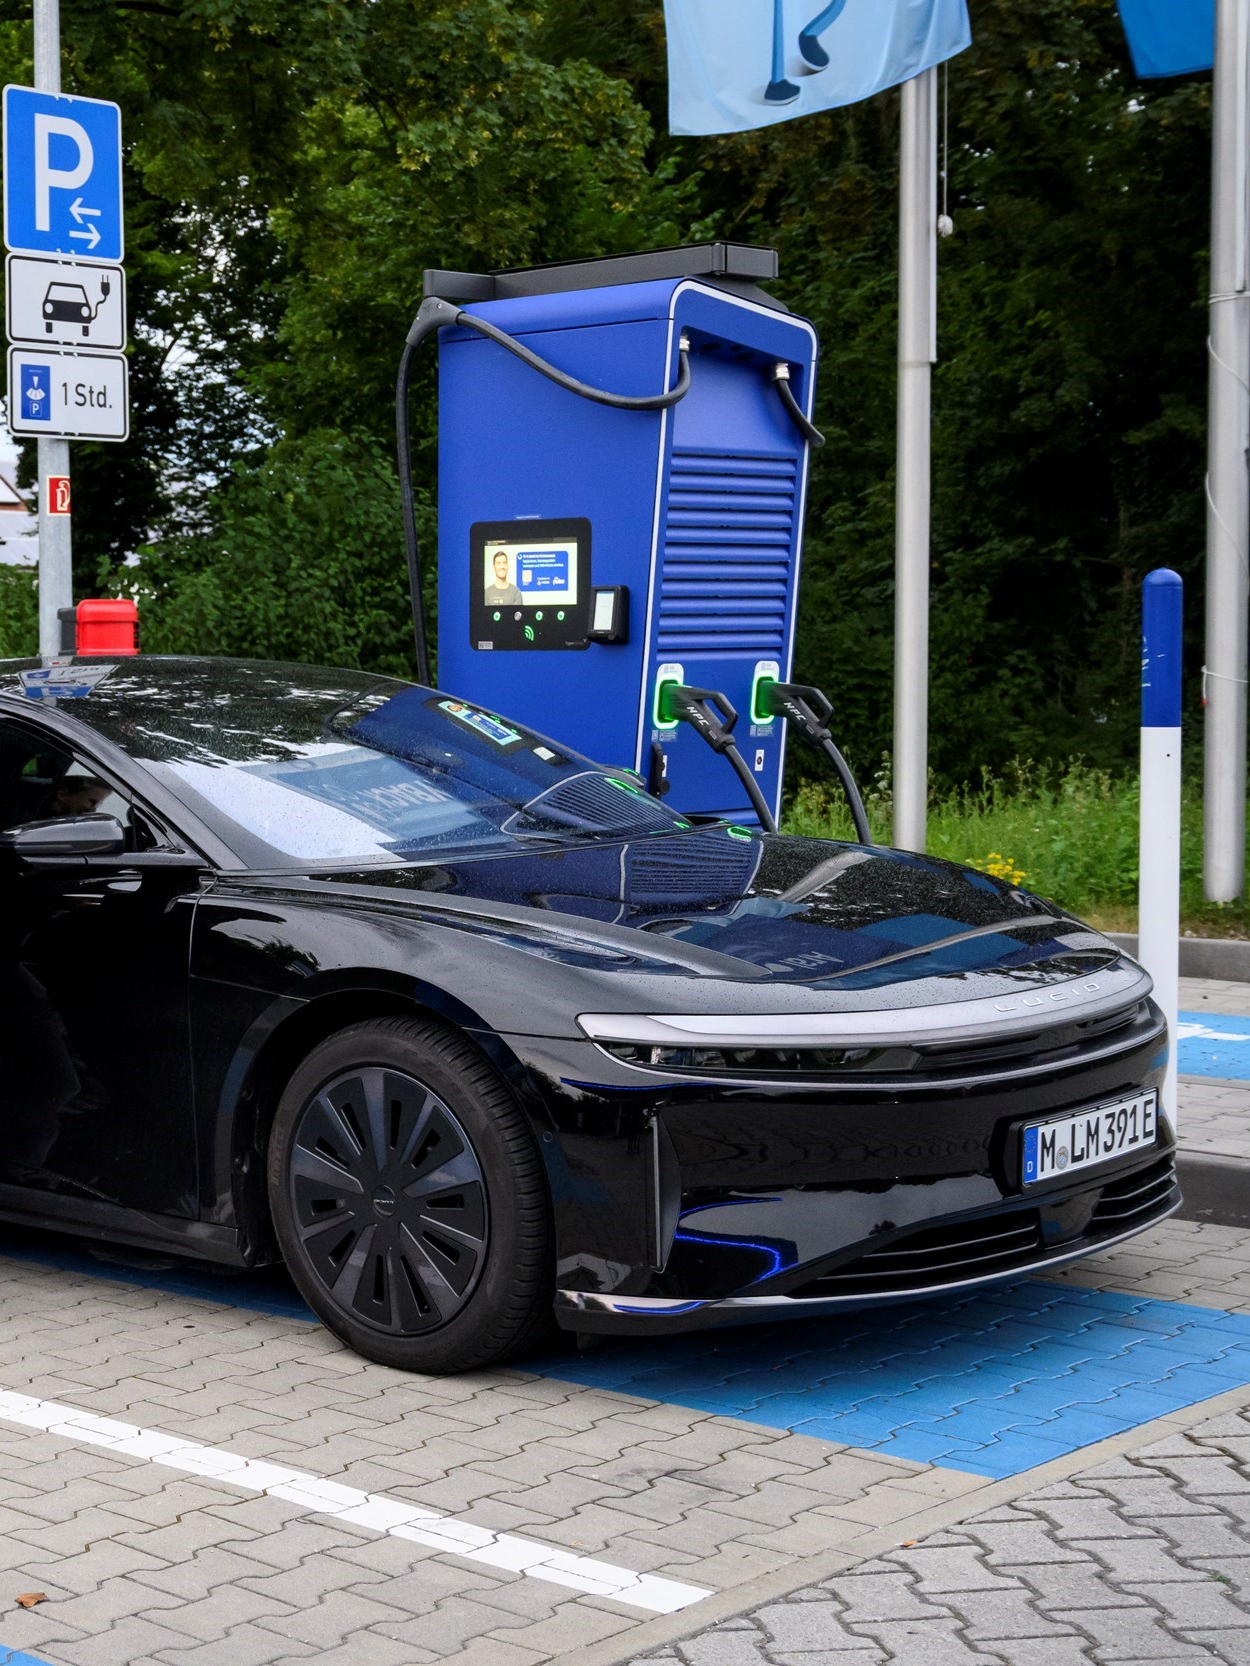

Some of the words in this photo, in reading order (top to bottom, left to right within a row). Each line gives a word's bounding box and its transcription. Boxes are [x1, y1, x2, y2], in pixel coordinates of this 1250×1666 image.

[34, 113, 95, 232] P
[61, 382, 68, 406] 1
[74, 383, 113, 409] Std.
[32, 404, 40, 415] P
[686, 706, 710, 726] HPC
[783, 702, 807, 721] HPC
[993, 982, 1101, 1013] LUCID
[1026, 1161, 1034, 1173] D
[1040, 1129, 1056, 1173] M
